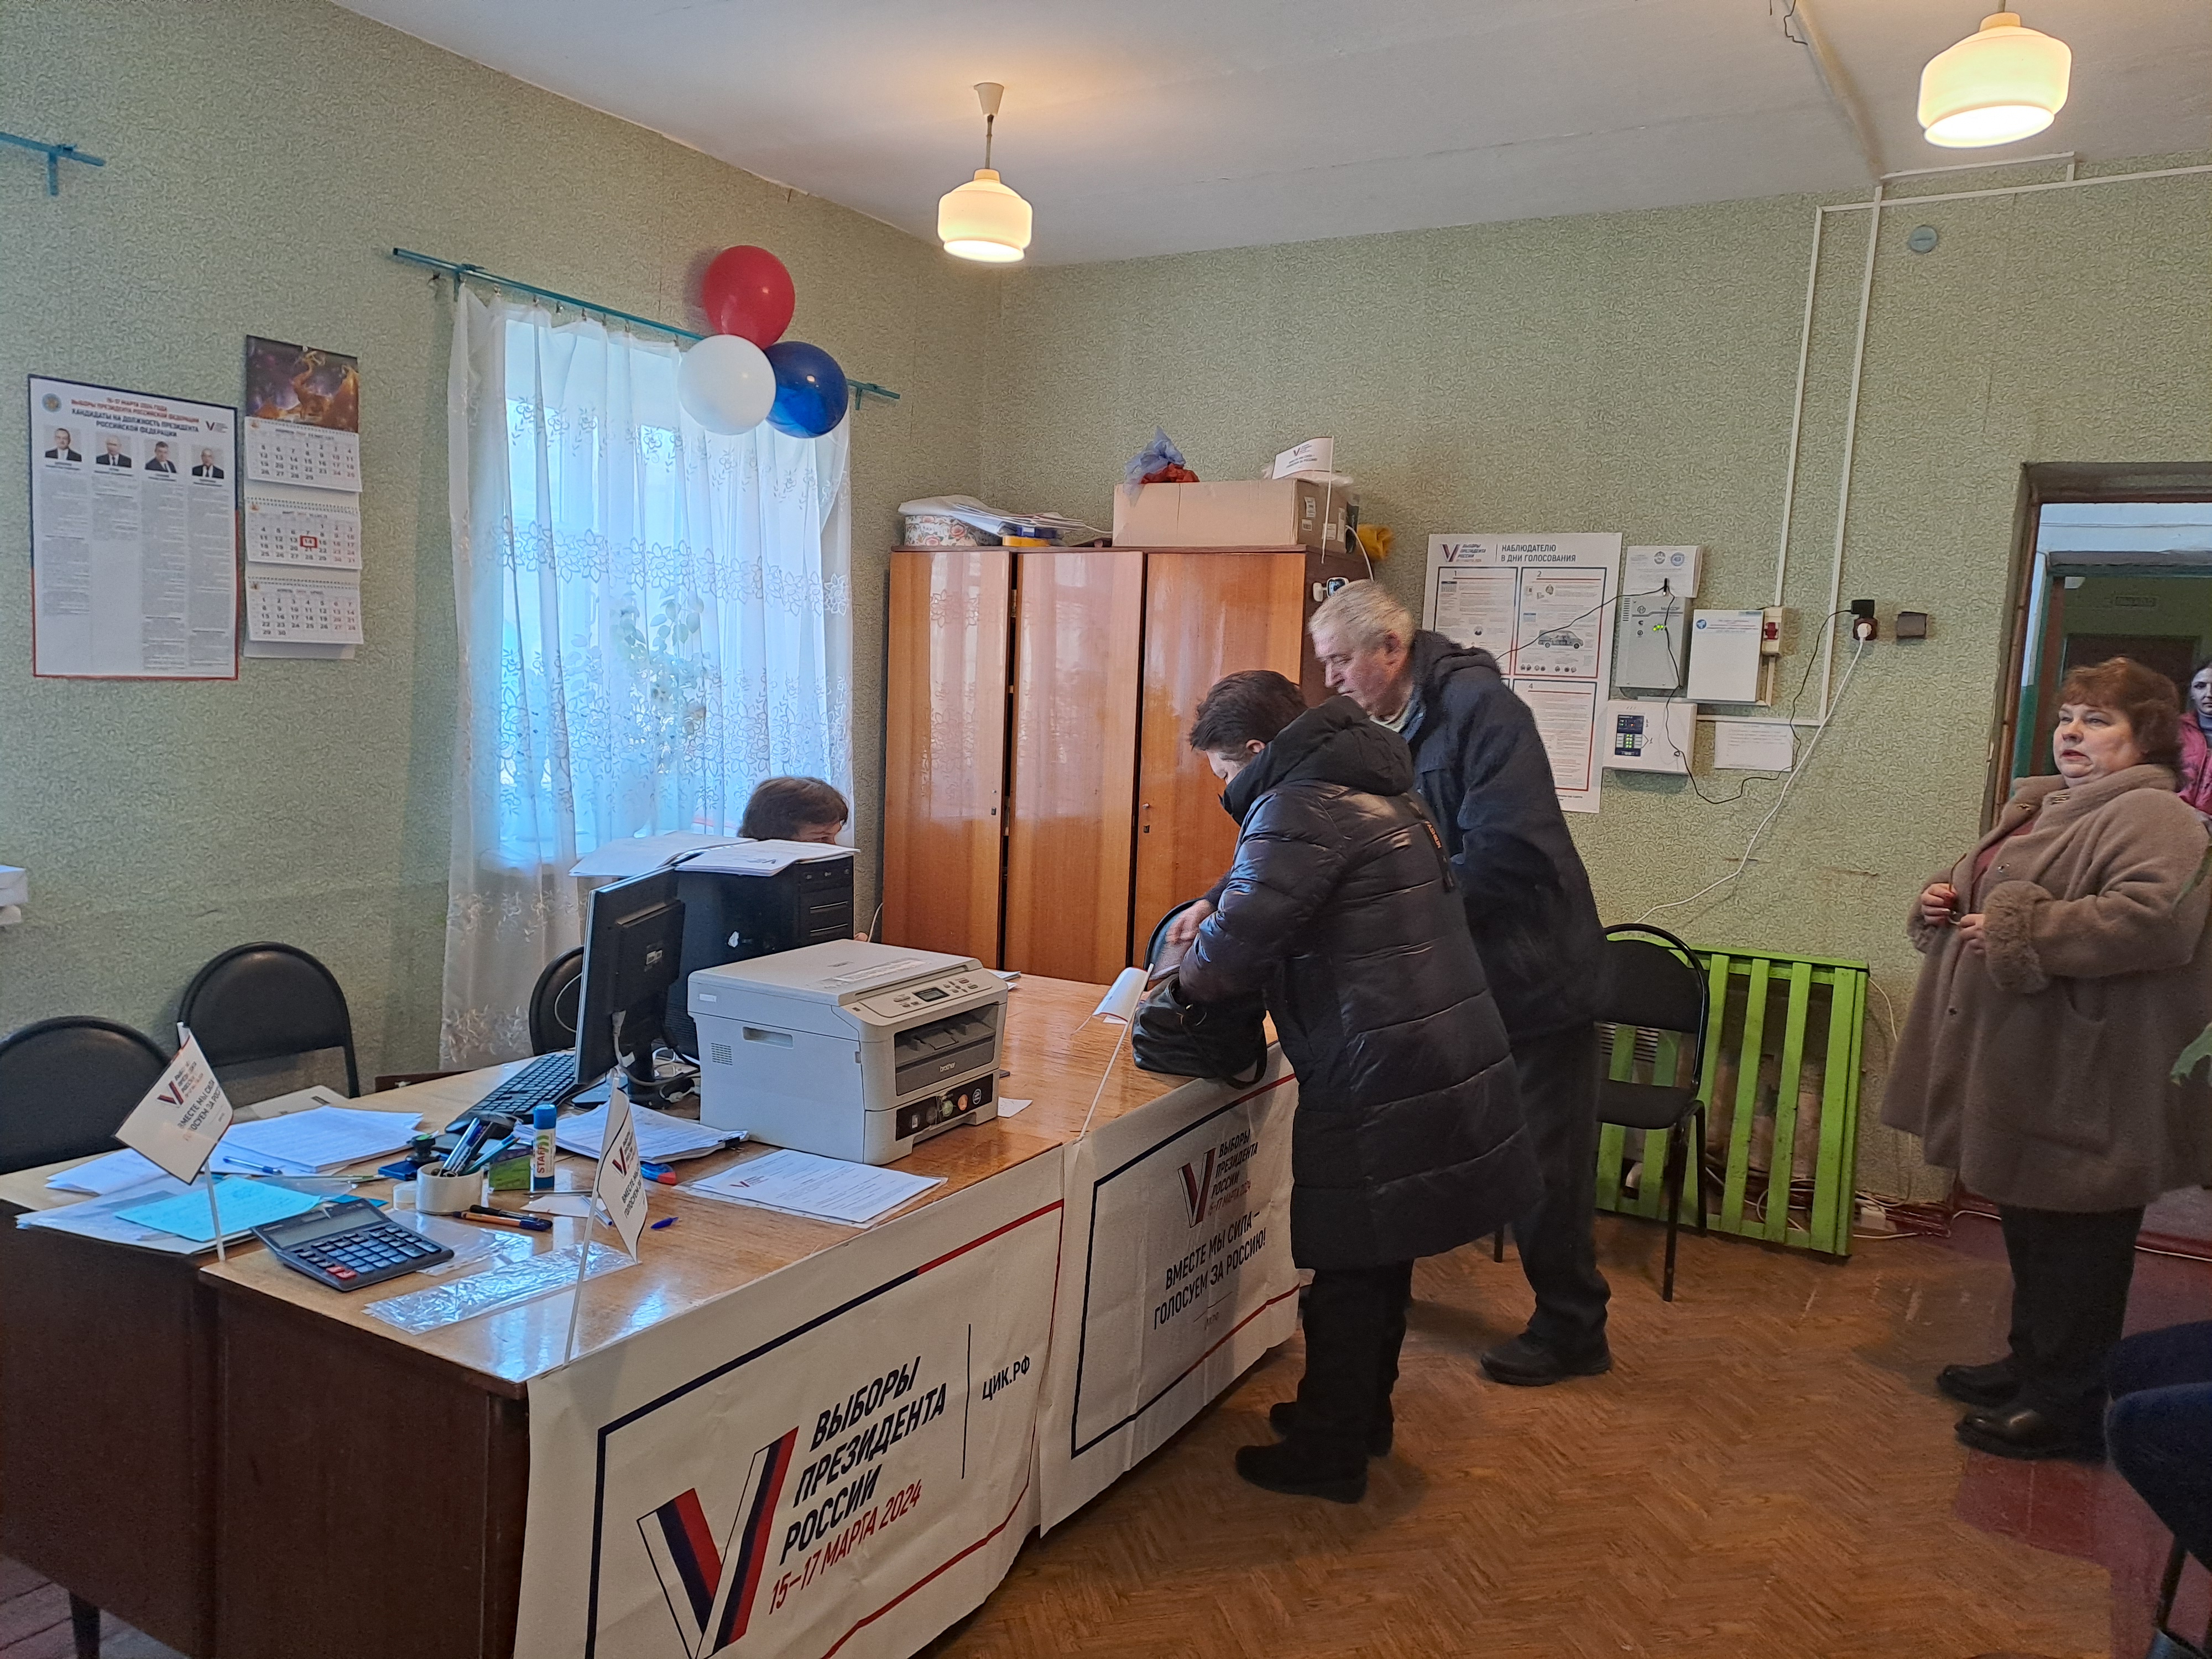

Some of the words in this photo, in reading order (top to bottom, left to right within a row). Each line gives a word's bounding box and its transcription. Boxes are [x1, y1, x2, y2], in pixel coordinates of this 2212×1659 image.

[1502, 544, 1556, 552] НАБЛЮДАТЕЛЮ
[1507, 554, 1522, 562] ДНИ
[537, 1145, 545, 1173] STAFF
[1215, 1142, 1258, 1178] ПРЕЗИДЕНТА
[1219, 1128, 1251, 1158] ВЫБОРЫ
[1211, 1170, 1239, 1199] РОССИИ
[1166, 1243, 1207, 1290] ВМЕСТЕ
[1209, 1229, 1225, 1259] МЫ
[1228, 1211, 1252, 1244] СИЛА
[1154, 1270, 1208, 1330] ГОЛОСУЕМ
[1210, 1260, 1224, 1286] ЗА
[1227, 1227, 1266, 1276] РОССИЮ!
[982, 1355, 1030, 1401] ЦИК.РФ
[810, 1356, 921, 1452] ВЫБОРЫ
[793, 1383, 946, 1508] ПРЕЗИДЕНТА
[779, 1463, 883, 1566] РОССИИ
[820, 1506, 878, 1575] МАРТА
[878, 1479, 922, 1531] 2024
